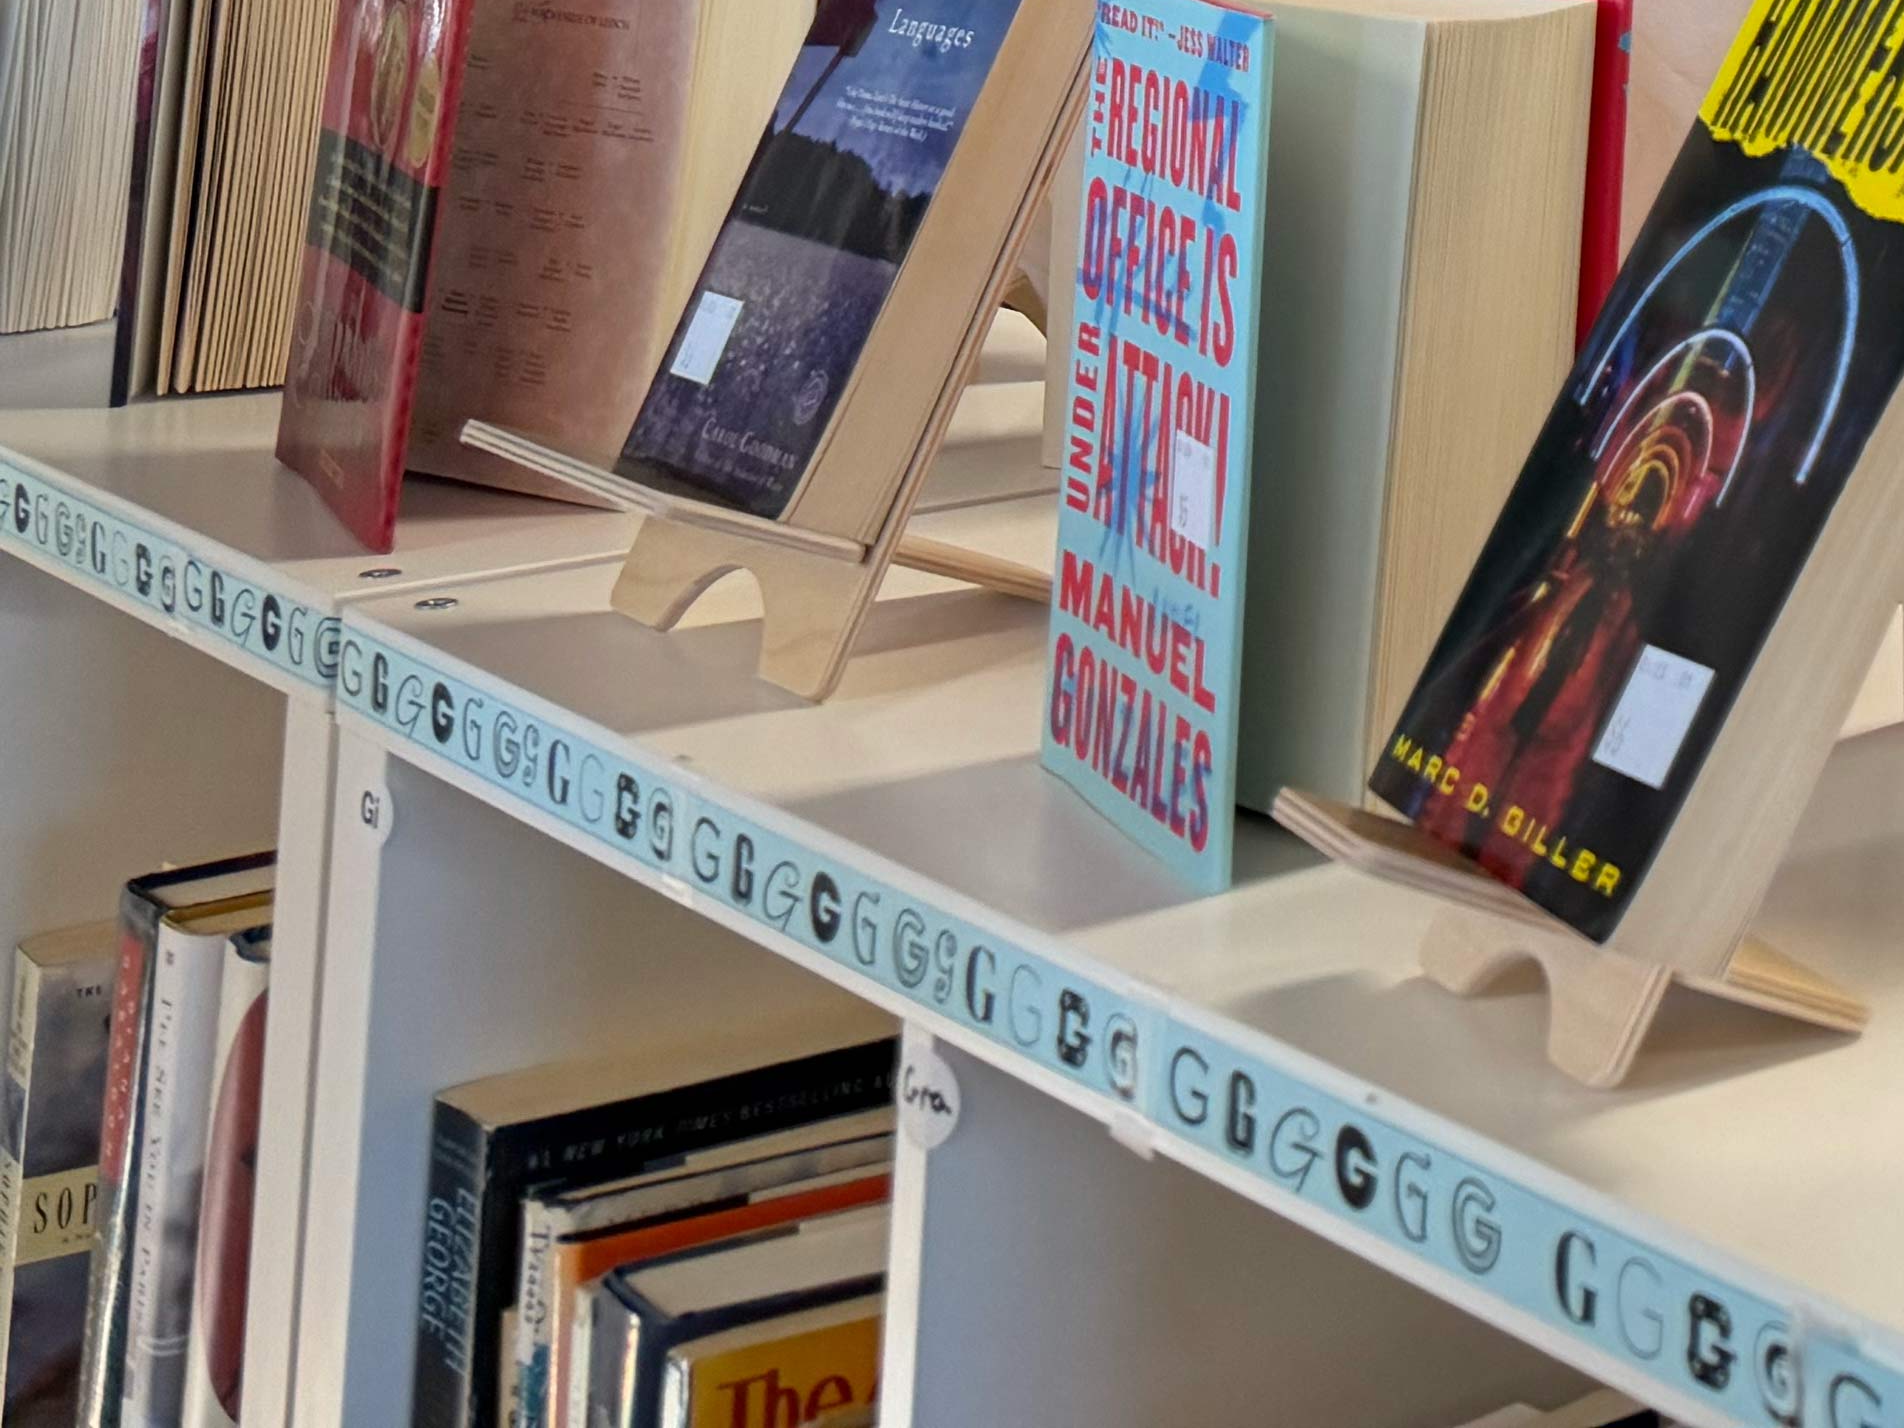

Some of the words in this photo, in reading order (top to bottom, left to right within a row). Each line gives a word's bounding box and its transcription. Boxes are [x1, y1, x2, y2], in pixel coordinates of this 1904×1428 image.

[887, 7, 975, 54] Languages
[1206, 31, 1251, 73] WALTER
[1090, 55, 1109, 158] THE
[1106, 56, 1242, 213] REGIONAL
[1082, 176, 1197, 344] OFFICE
[1199, 225, 1239, 369] IS
[1066, 329, 1099, 513] UNDER
[1059, 548, 1216, 713] MANUEL
[361, 790, 380, 828] Gi
[1050, 632, 1213, 853] GONZALES
[1391, 733, 1461, 796] MARC
[1465, 782, 1490, 819] D.
[1501, 804, 1623, 898] GILLER
[738, 1076, 866, 1123] BESTSELLING
[422, 1194, 454, 1340] GEORGE
[444, 1185, 480, 1377] ELIZABETH
[715, 1365, 854, 1428] The
